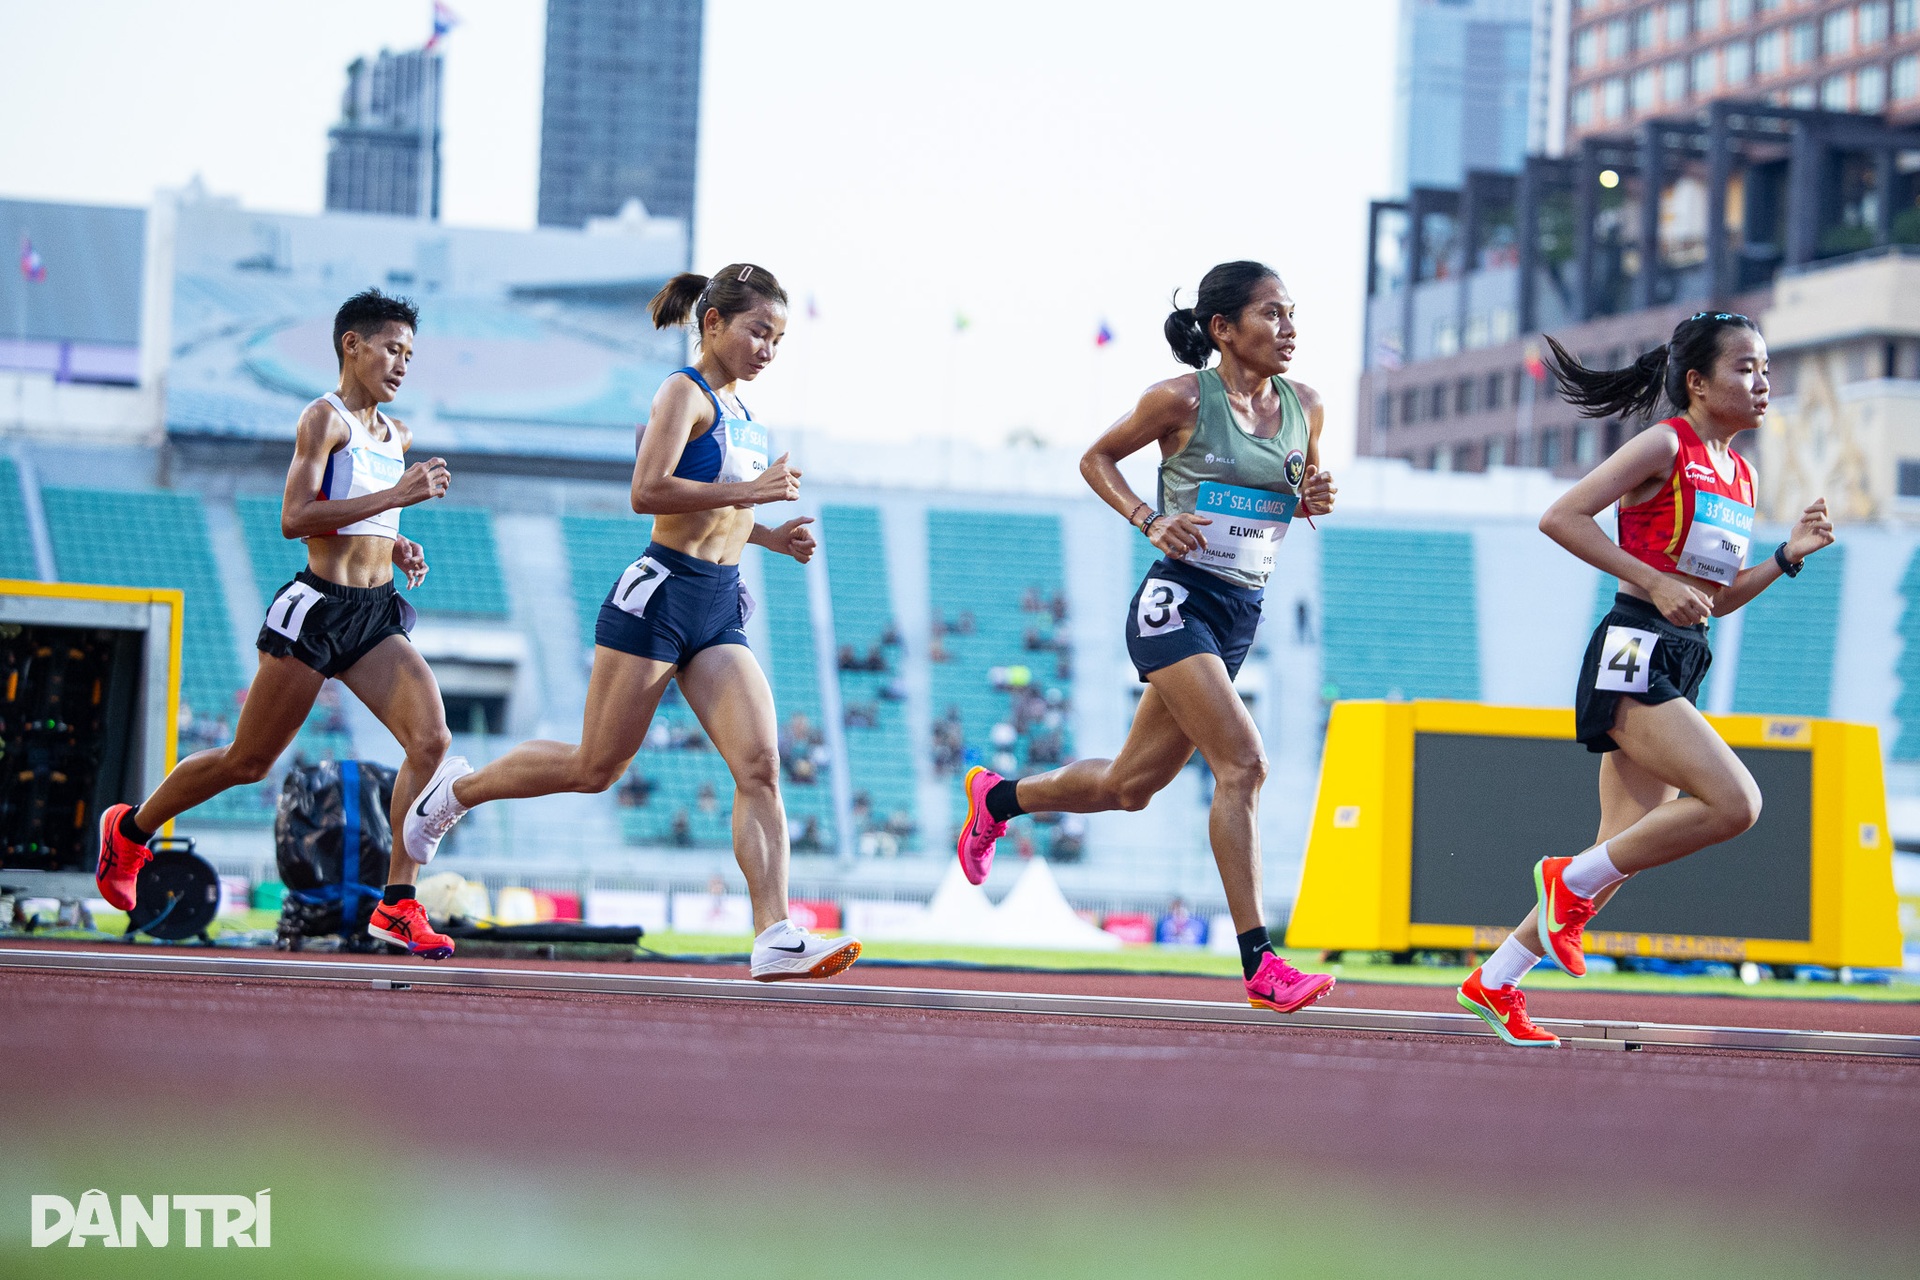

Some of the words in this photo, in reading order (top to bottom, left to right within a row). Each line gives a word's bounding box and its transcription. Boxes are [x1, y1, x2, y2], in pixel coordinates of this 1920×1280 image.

[1207, 490, 1231, 507] 33rd
[1229, 495, 1252, 511] SEA
[1254, 499, 1287, 515] GAMES
[1721, 507, 1736, 526] SEA
[1229, 525, 1265, 539] ELVINA
[1202, 548, 1237, 560] THAILAND
[1721, 539, 1741, 555] TUYET
[1697, 562, 1726, 576] THAILAND
[622, 562, 660, 602] 7
[286, 592, 306, 630] 1
[1144, 586, 1175, 629] 3
[1607, 636, 1643, 684] 4
